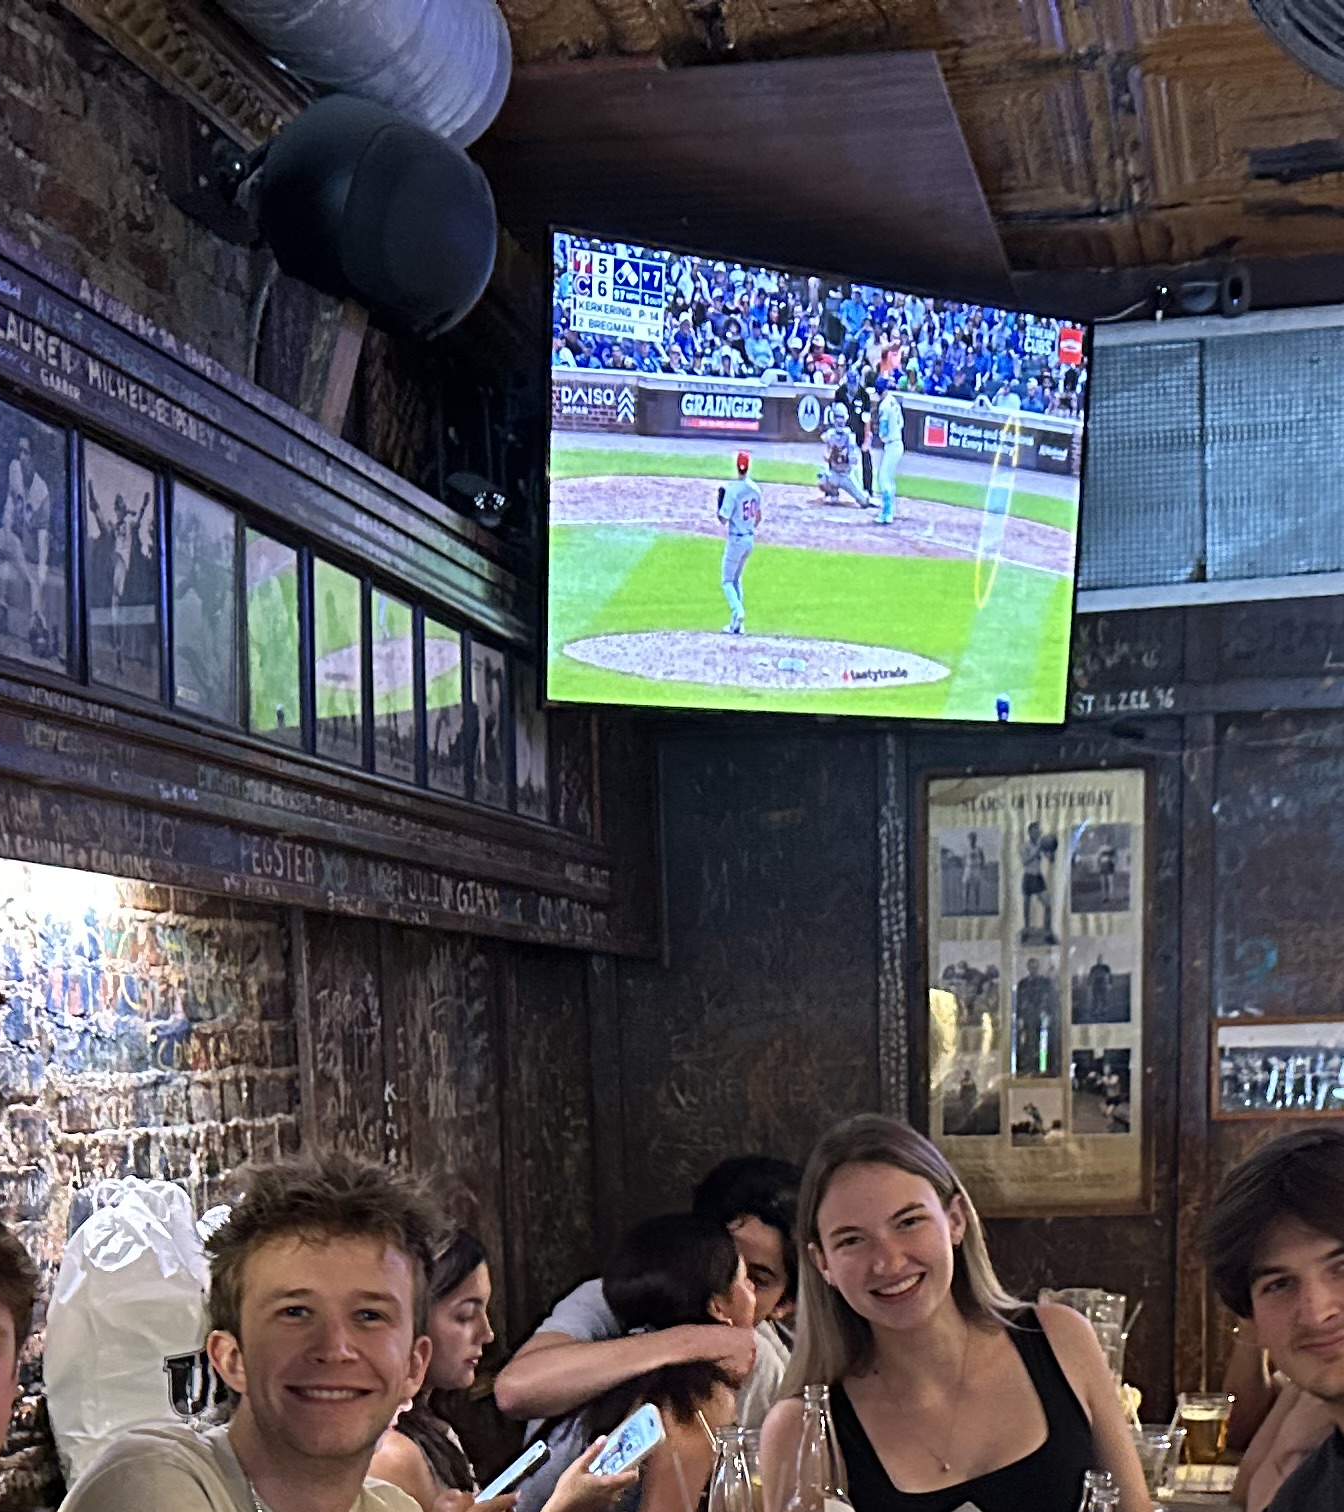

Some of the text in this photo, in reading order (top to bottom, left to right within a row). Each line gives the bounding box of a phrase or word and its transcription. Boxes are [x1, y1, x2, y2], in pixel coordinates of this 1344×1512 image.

[598, 258, 608, 274] 5
[597, 281, 607, 297] 6
[681, 393, 763, 419] GRAINGER
